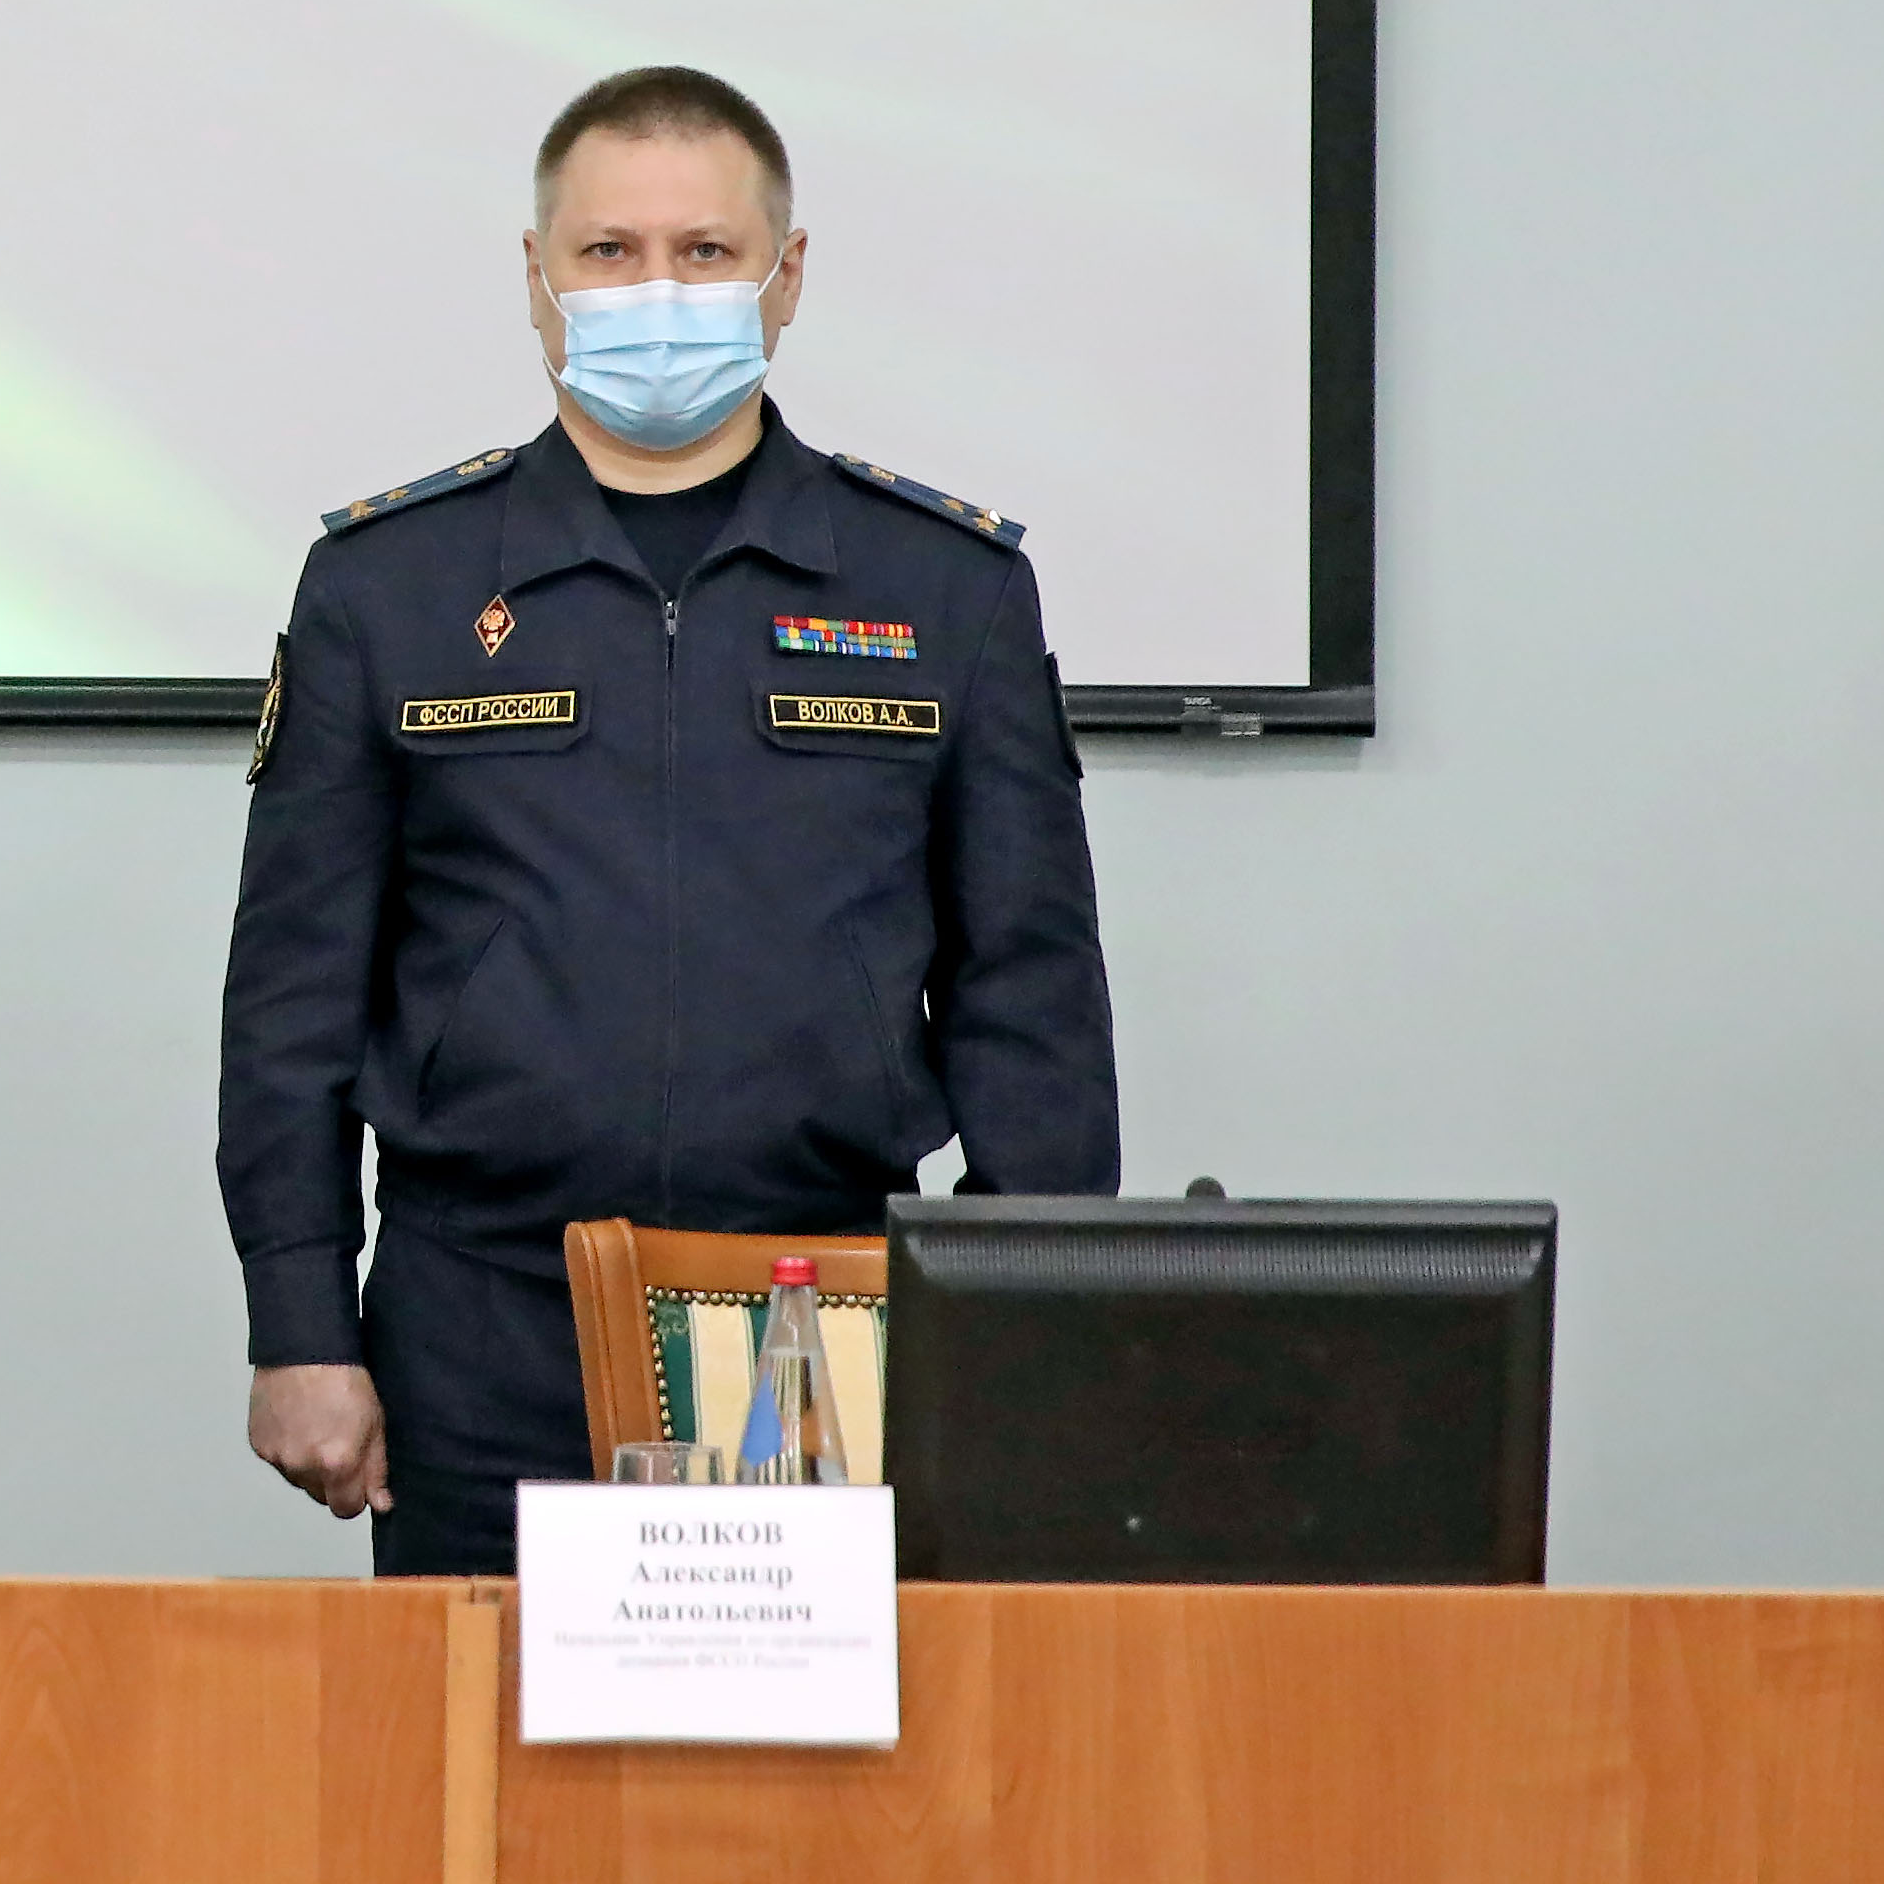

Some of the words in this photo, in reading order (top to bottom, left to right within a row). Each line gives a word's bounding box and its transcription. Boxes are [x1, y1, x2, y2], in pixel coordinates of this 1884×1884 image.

[419, 704, 474, 725] ФССП
[478, 697, 558, 720] РОССИИ
[797, 700, 875, 724] ВОЛКОВ
[879, 704, 914, 726] А.А.
[638, 1521, 784, 1546] ВОЛКОВ
[631, 1561, 793, 1589] Александр
[613, 1600, 813, 1623] Анатольевич
